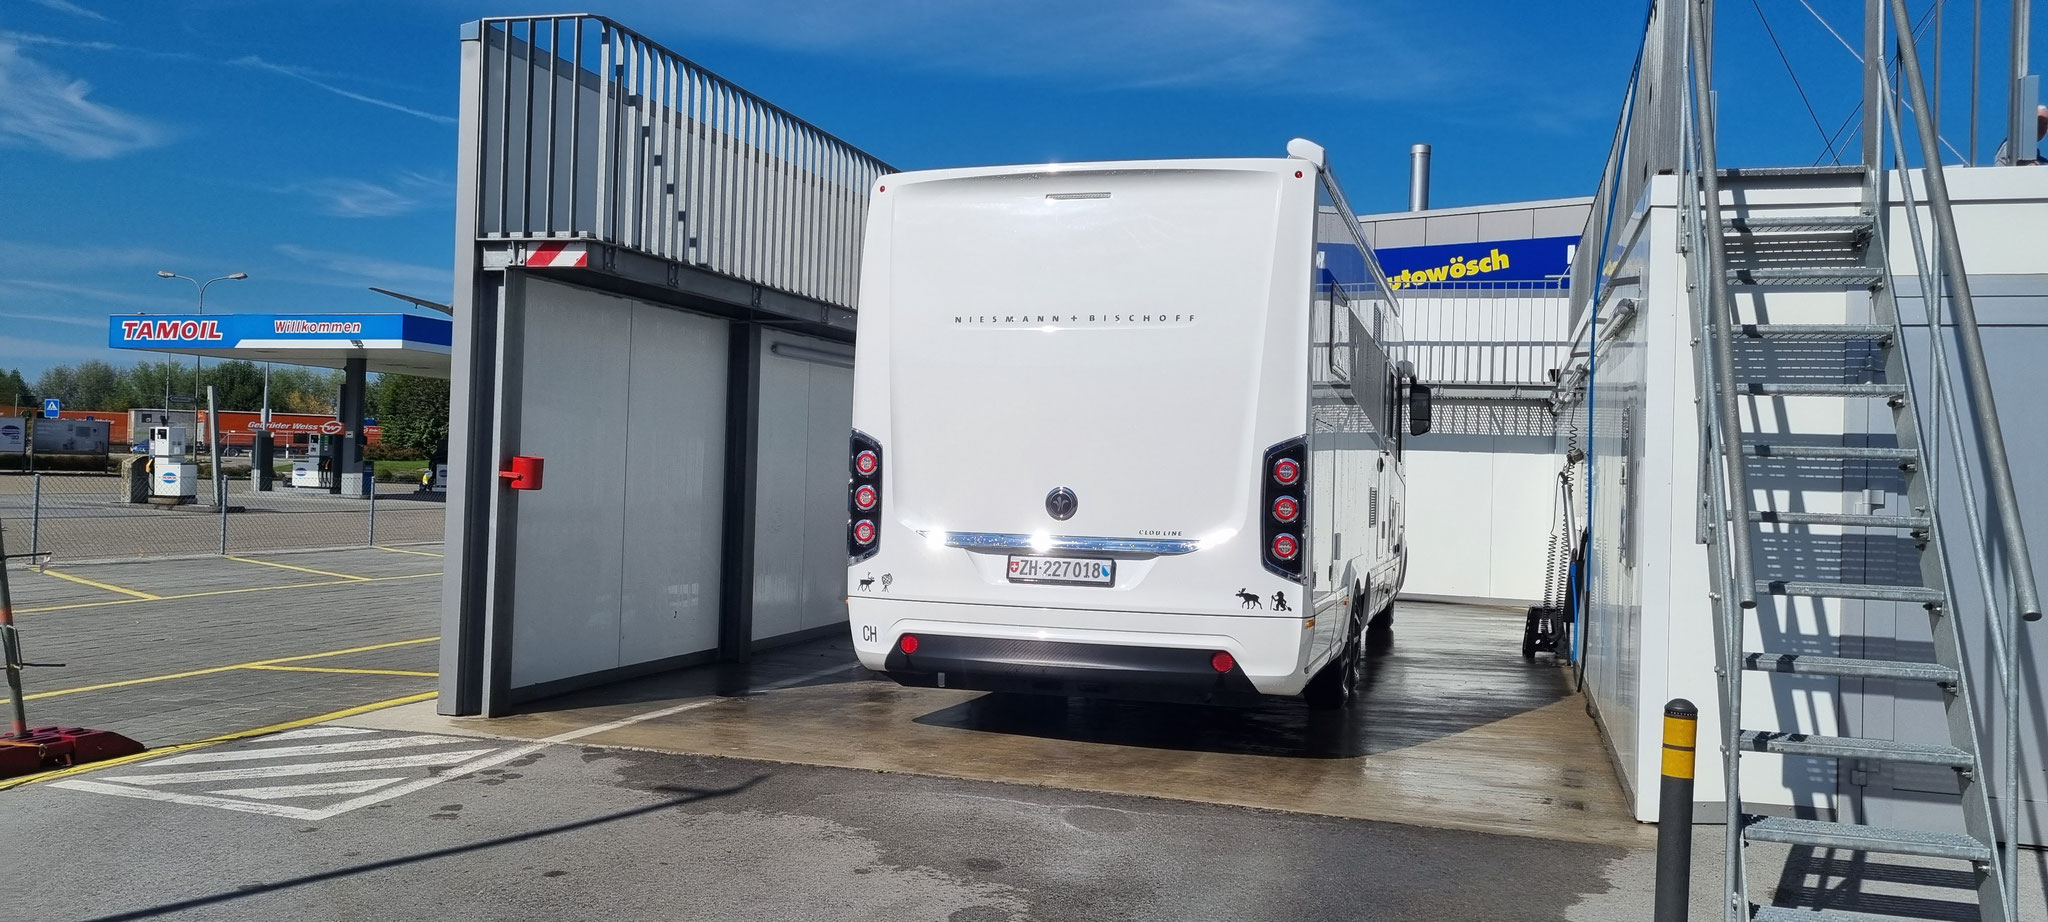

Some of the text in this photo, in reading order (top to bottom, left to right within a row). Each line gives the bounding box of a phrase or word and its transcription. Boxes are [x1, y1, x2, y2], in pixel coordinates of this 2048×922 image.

[1386, 248, 1510, 291] utowösch
[274, 320, 361, 333] Willkommen
[954, 315, 1060, 324] NIESMANN
[1089, 314, 1195, 323] BISCHOFF
[122, 320, 223, 341] TAMOIL
[863, 625, 877, 642] CH
